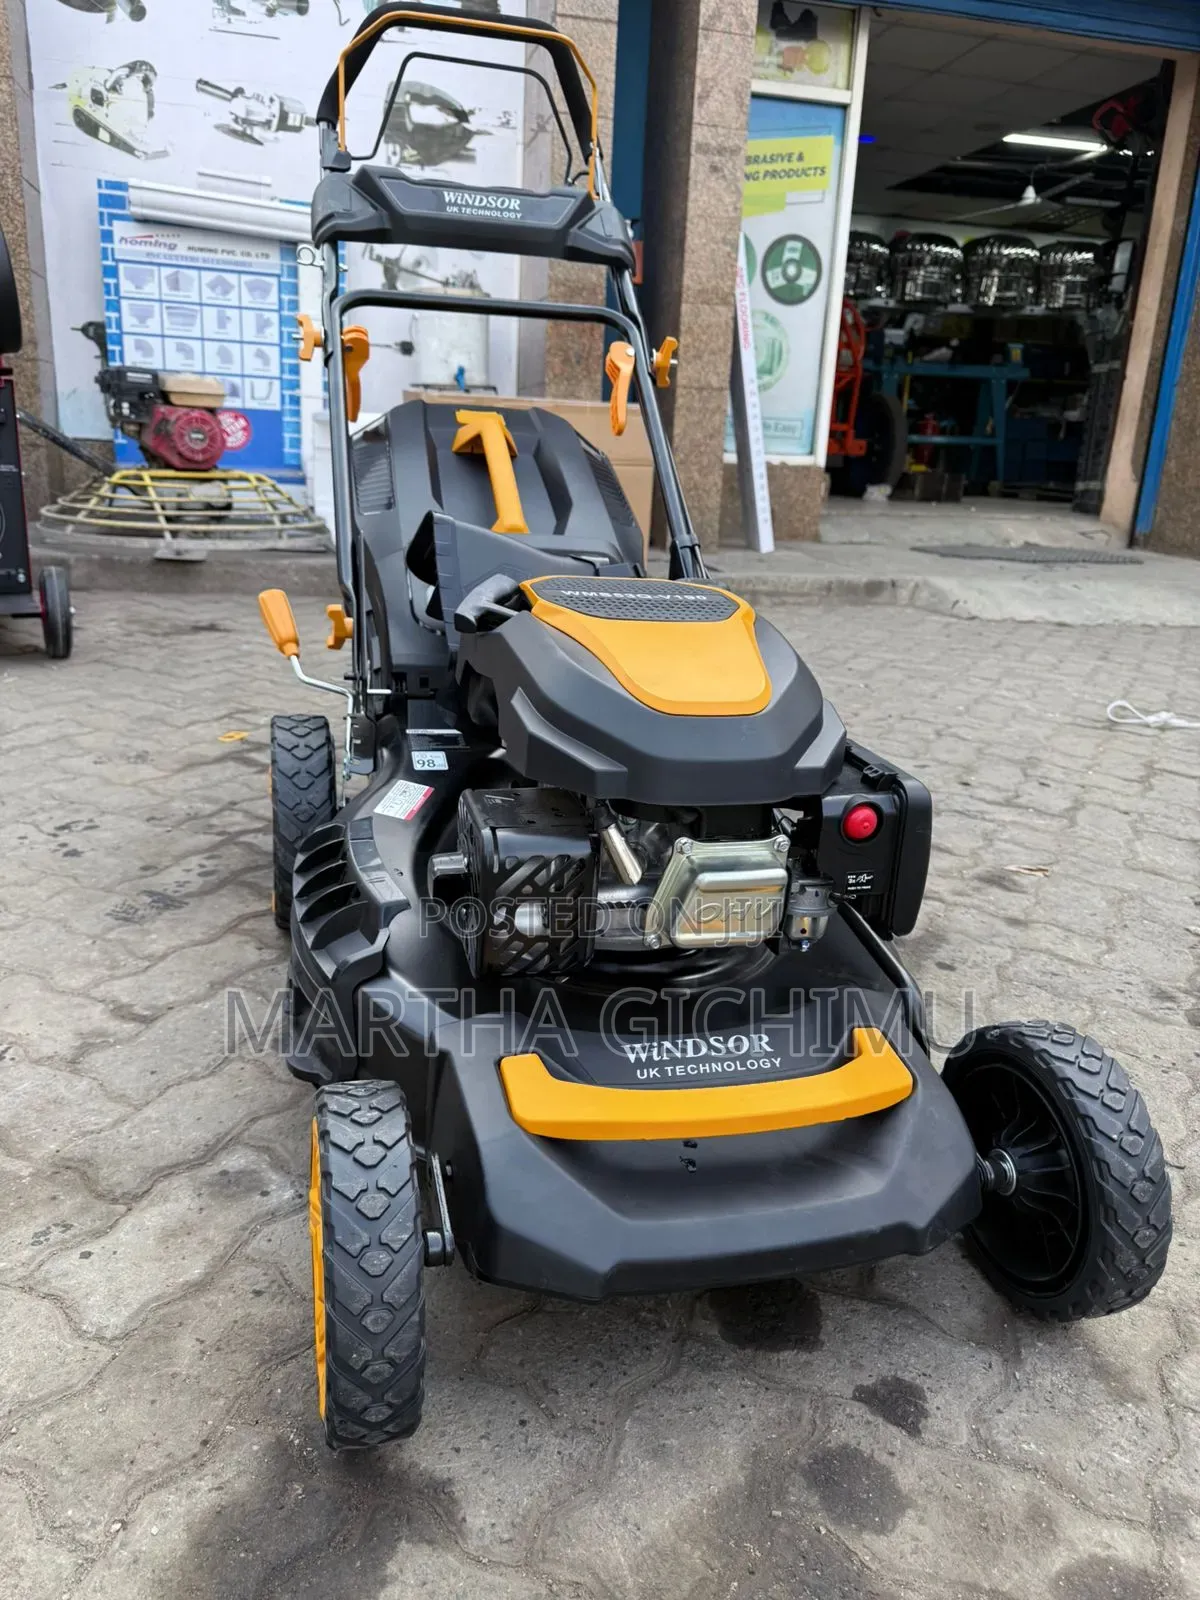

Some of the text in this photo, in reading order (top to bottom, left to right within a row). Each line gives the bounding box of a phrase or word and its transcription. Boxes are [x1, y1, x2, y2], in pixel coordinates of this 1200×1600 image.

[796, 151, 804, 163] &
[762, 165, 826, 181] PRODUCTS
[442, 191, 521, 210] WiNDSOR
[446, 205, 522, 219] UK TECHNOLOGY
[118, 236, 178, 251] homing
[417, 759, 436, 768] 98
[621, 1033, 774, 1064] WiNDSOR
[636, 1057, 782, 1079] UK TECHNOLOGY
